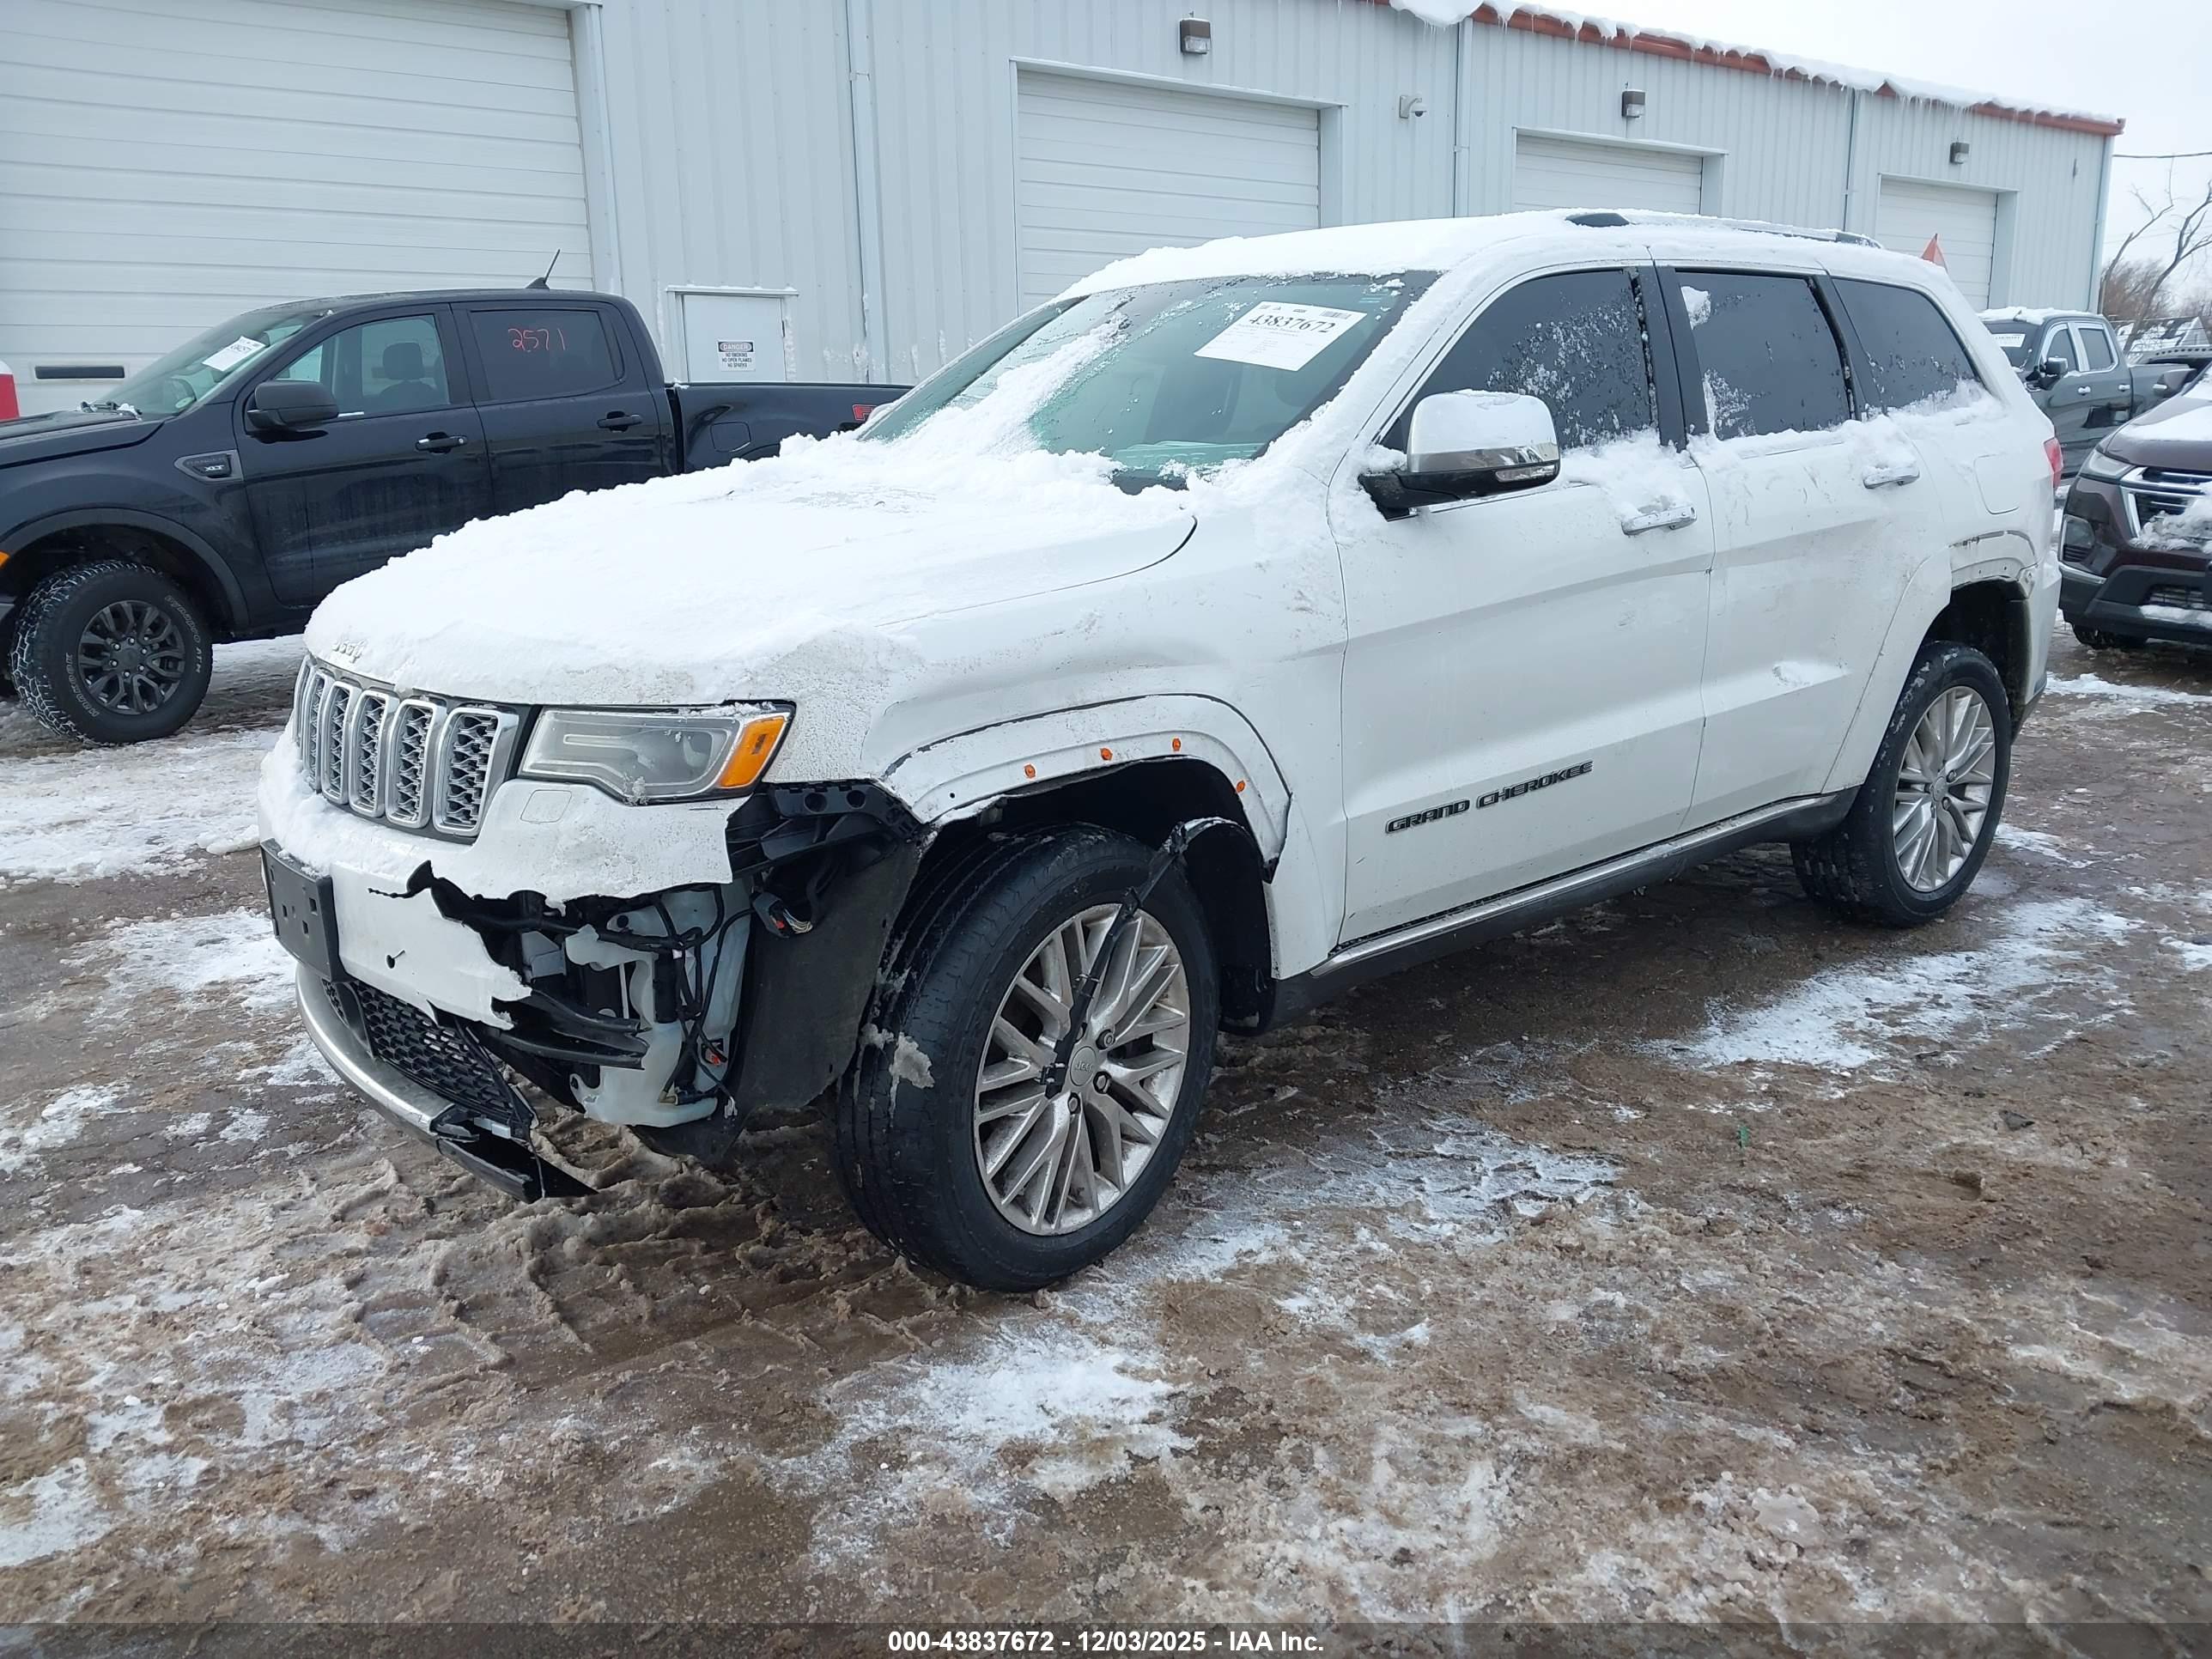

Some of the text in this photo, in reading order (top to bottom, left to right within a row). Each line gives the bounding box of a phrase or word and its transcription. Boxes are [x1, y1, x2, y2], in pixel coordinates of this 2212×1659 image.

[1249, 313, 1336, 333] 43837672
[507, 327, 566, 350] 2571
[1385, 760, 1594, 834] GRAND CHEROKEE
